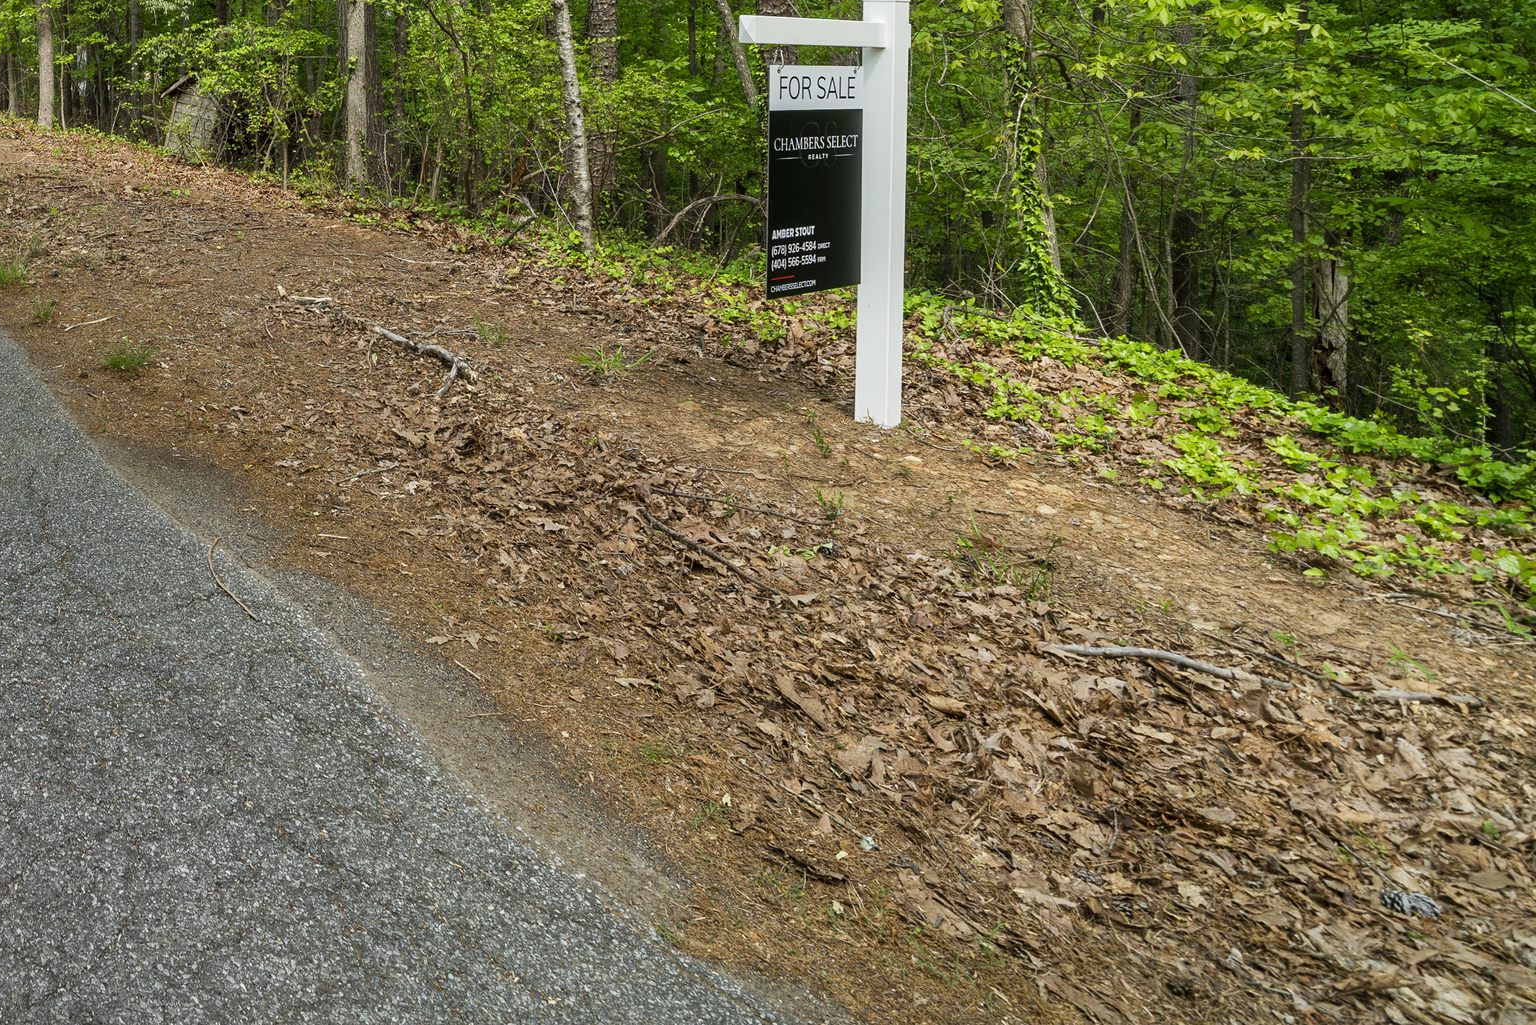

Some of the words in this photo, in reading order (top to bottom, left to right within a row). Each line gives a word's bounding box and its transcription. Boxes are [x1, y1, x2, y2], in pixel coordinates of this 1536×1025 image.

[779, 75, 812, 100] FOR
[817, 75, 856, 100] SALE
[773, 136, 825, 151] CHAMBERS
[826, 134, 858, 148] SELECT
[772, 228, 794, 240] AMBER
[795, 225, 816, 237] STOUT
[771, 244, 787, 258] (678)
[788, 240, 816, 254] 926-4584
[771, 258, 787, 272] (404)
[788, 254, 816, 267] 566-5594
[771, 280, 816, 293] CHAMBERSSELECT.COM
